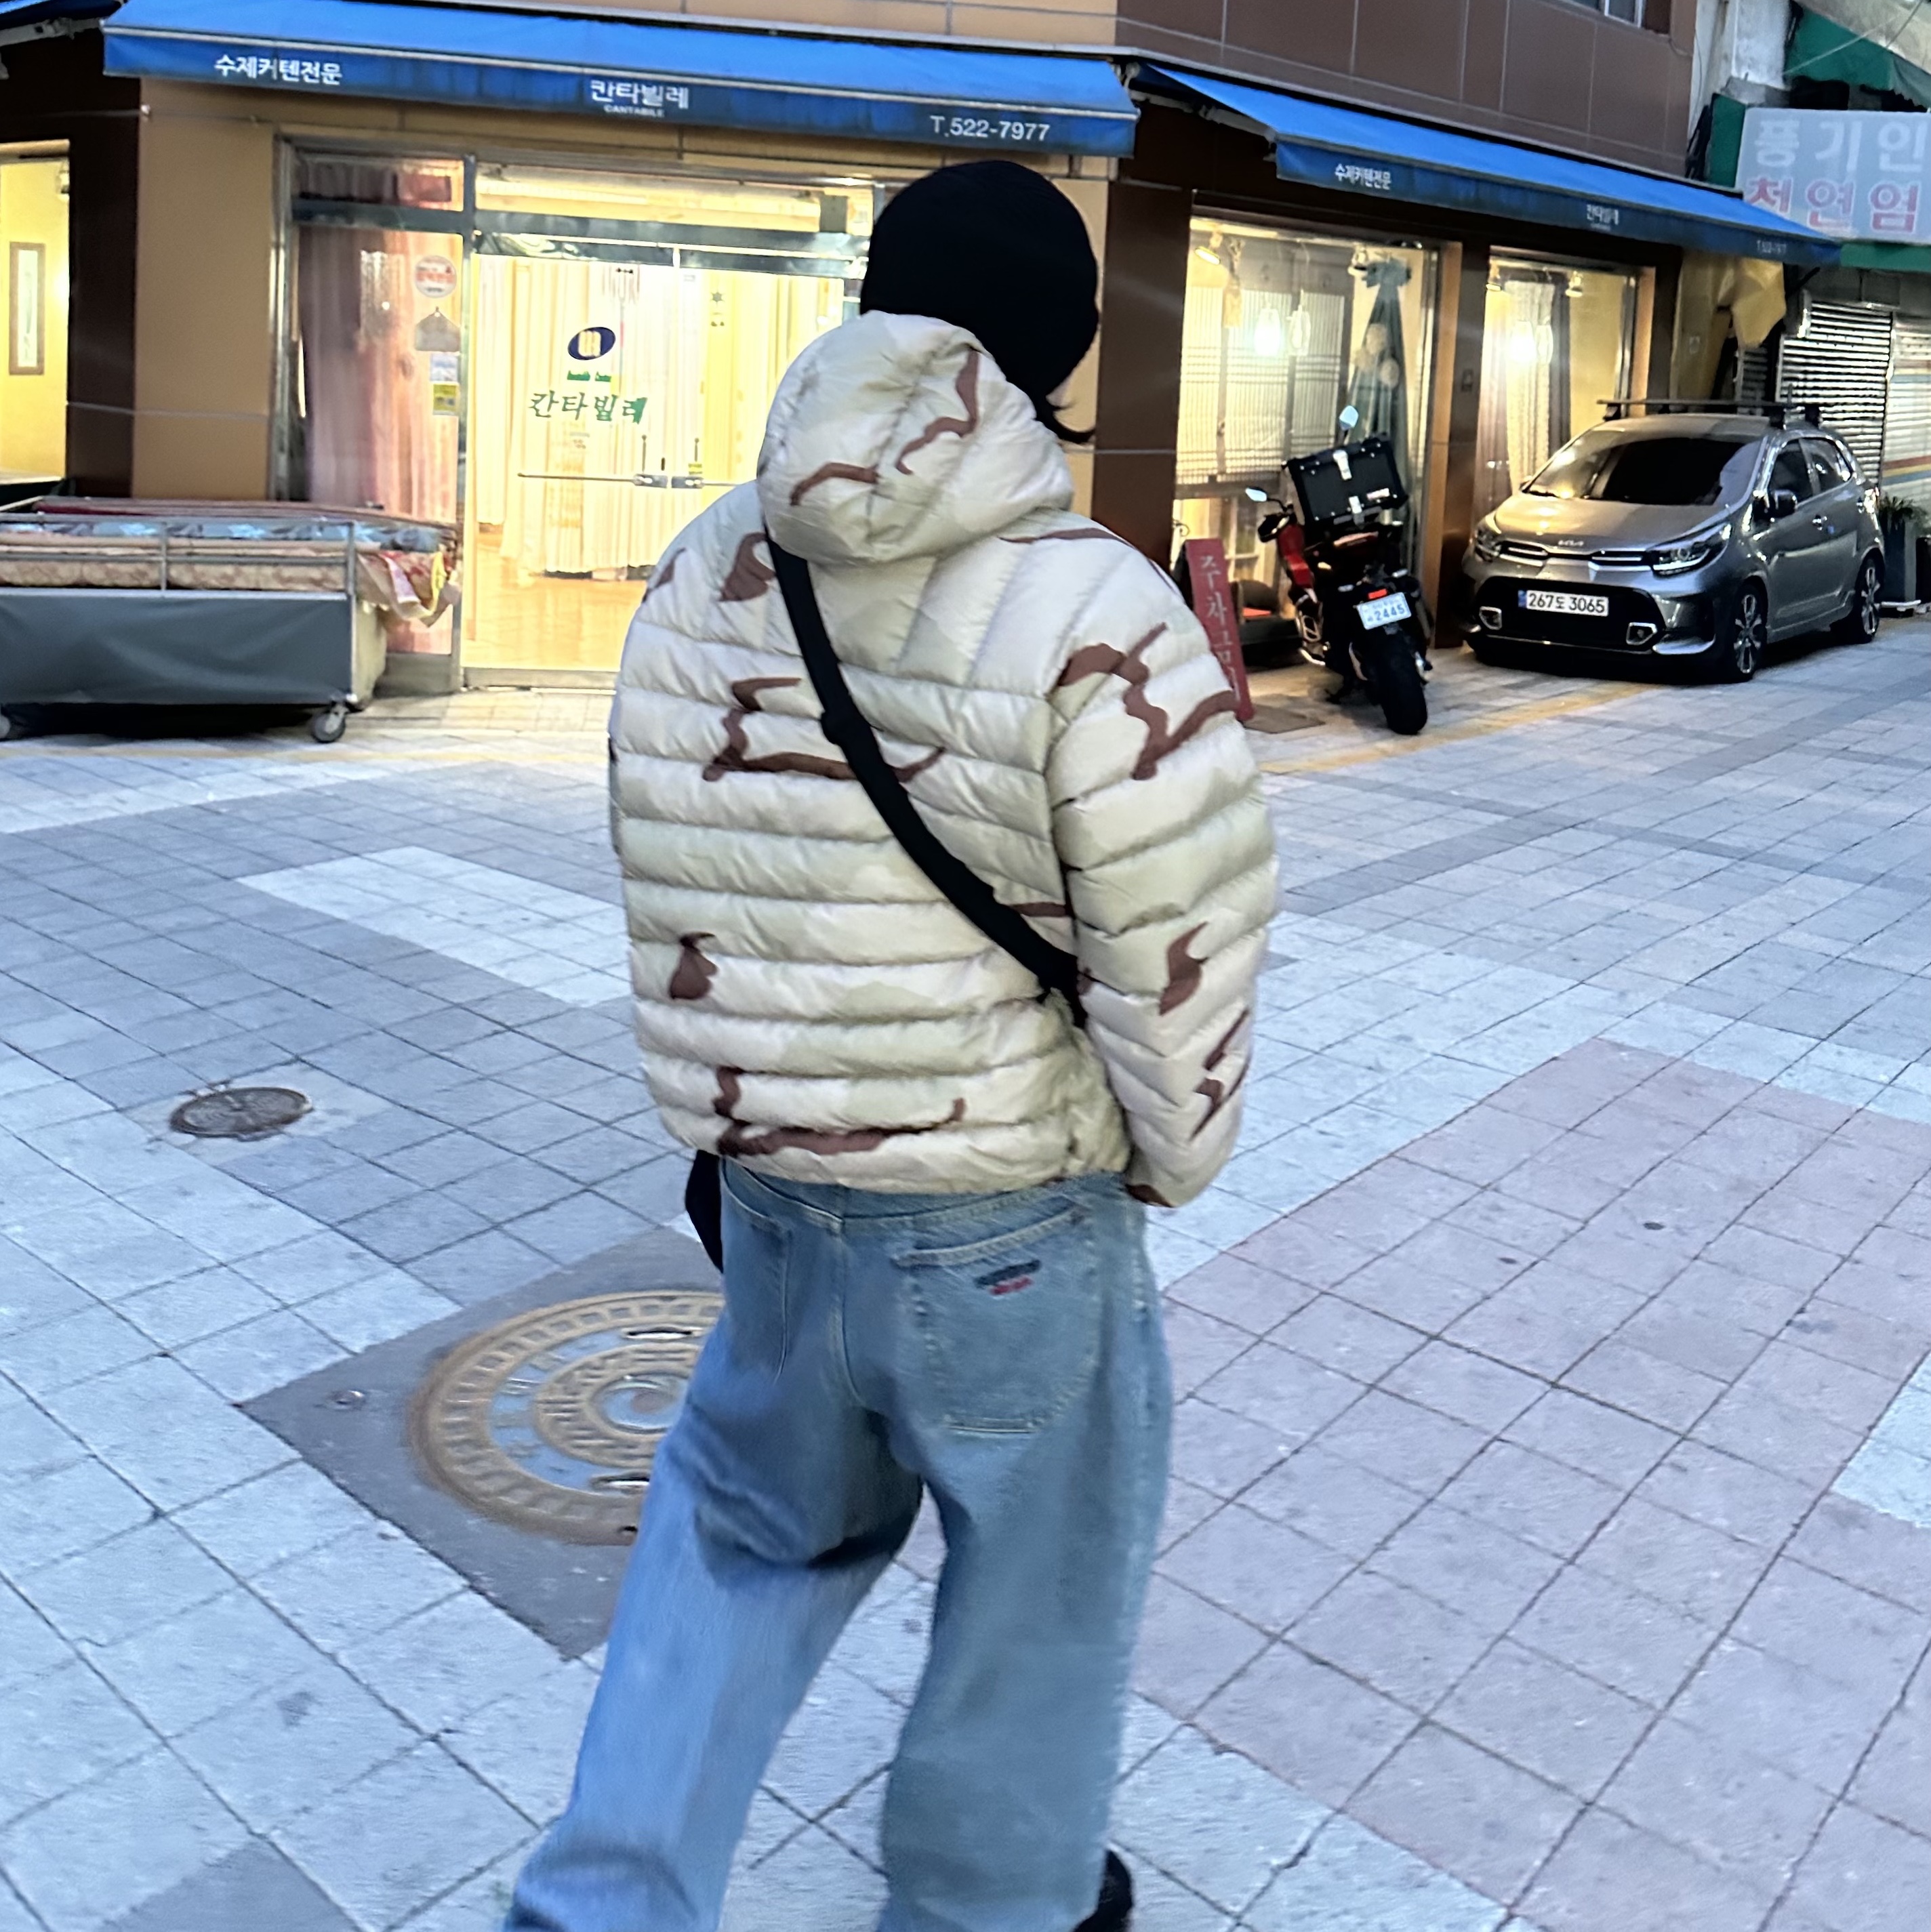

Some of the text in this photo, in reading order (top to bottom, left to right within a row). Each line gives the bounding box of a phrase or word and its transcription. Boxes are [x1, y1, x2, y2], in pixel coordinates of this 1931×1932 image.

[214, 54, 343, 86] 수제커텐전문
[590, 79, 689, 109] 칸타빌레
[929, 115, 1050, 141] T.522-7977
[1754, 119, 1928, 172] 풍기인
[528, 389, 648, 426] 칸타빌레
[1568, 596, 1606, 613] 3065
